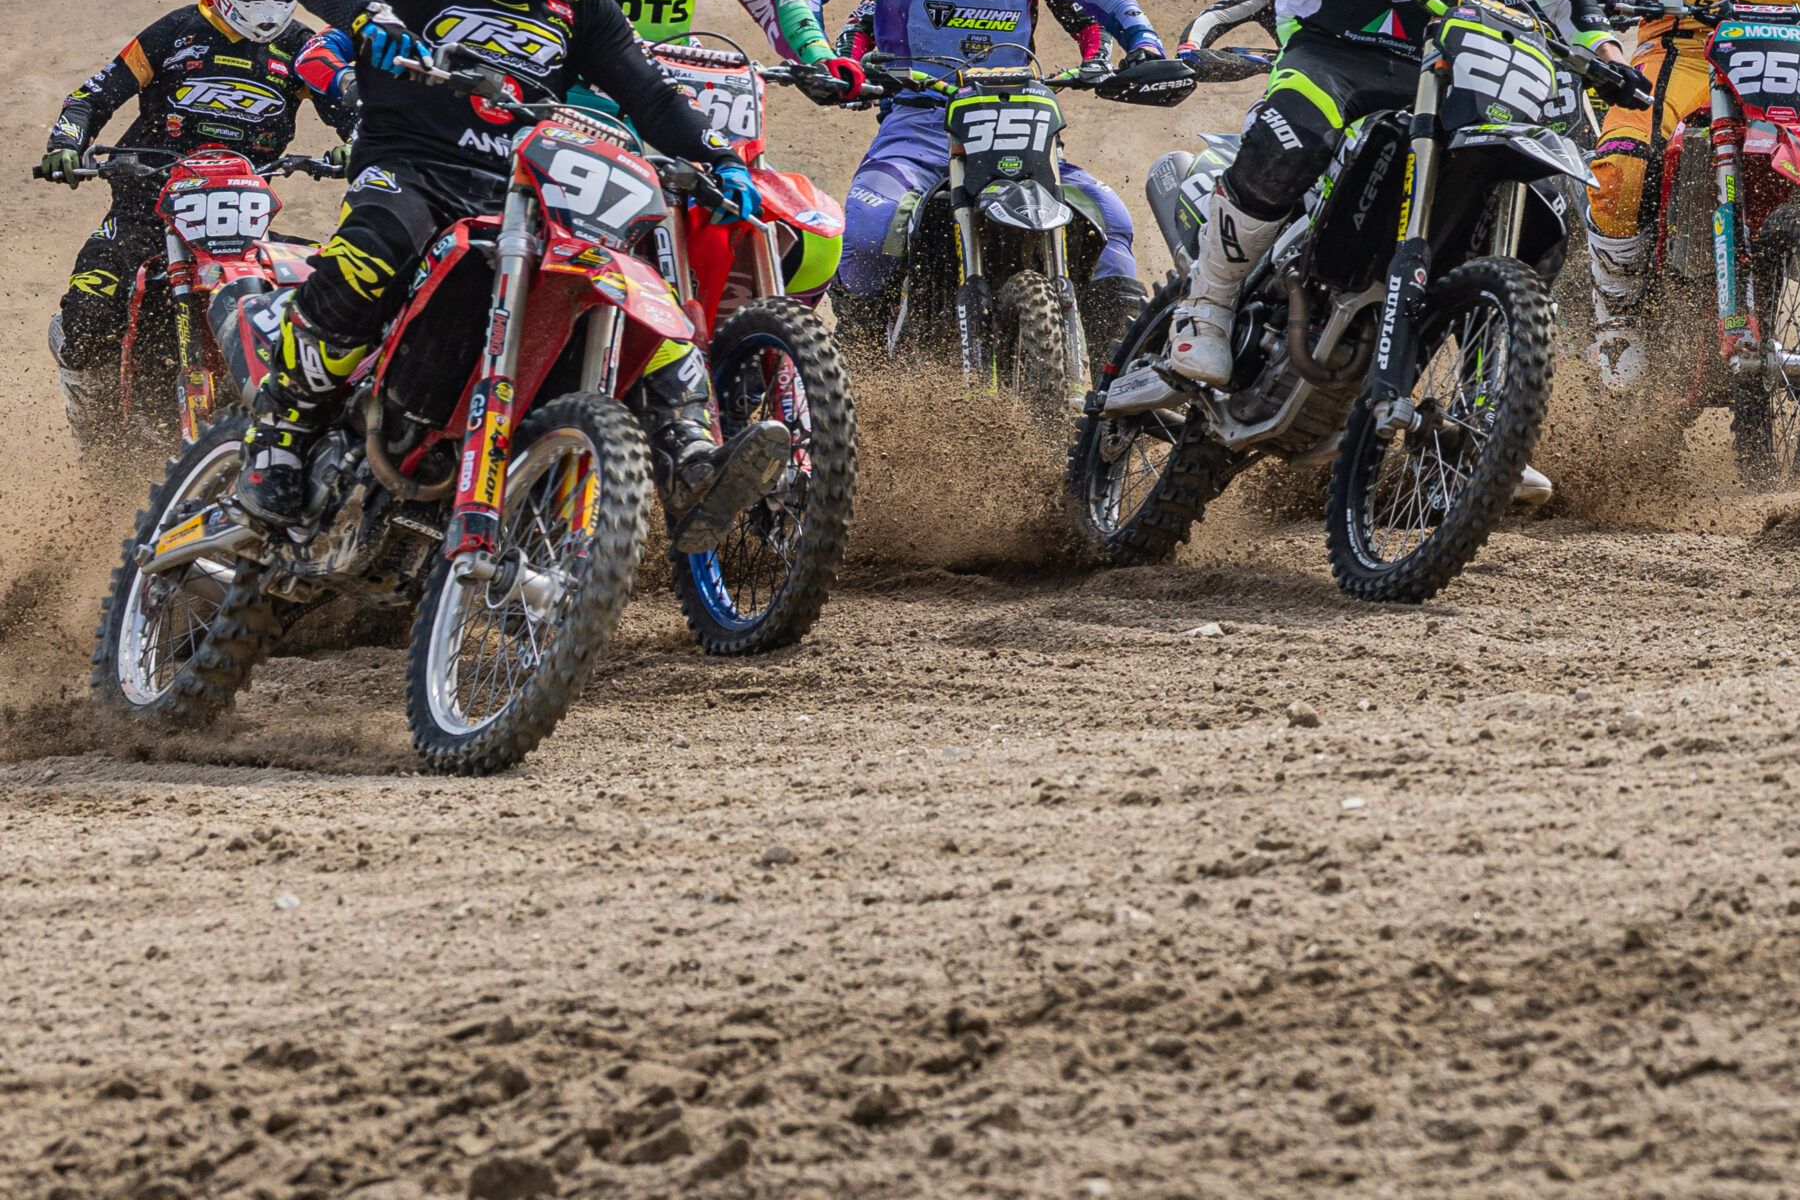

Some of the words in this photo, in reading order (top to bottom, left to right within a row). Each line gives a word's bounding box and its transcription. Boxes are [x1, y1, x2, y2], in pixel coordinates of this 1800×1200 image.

[947, 17, 1017, 32] RACING
[954, 6, 1022, 23] TRIUMPH
[1139, 78, 1194, 93] ACERBIS
[1455, 31, 1553, 123] 22
[553, 112, 627, 151] RENTHAL
[963, 109, 1052, 154] 351
[1261, 107, 1303, 151] SHOT
[226, 178, 260, 188] TAPIA
[541, 147, 655, 230] 97
[173, 191, 271, 241] 268
[1379, 274, 1402, 371] DUNLOP
[460, 449, 474, 492] REDD
